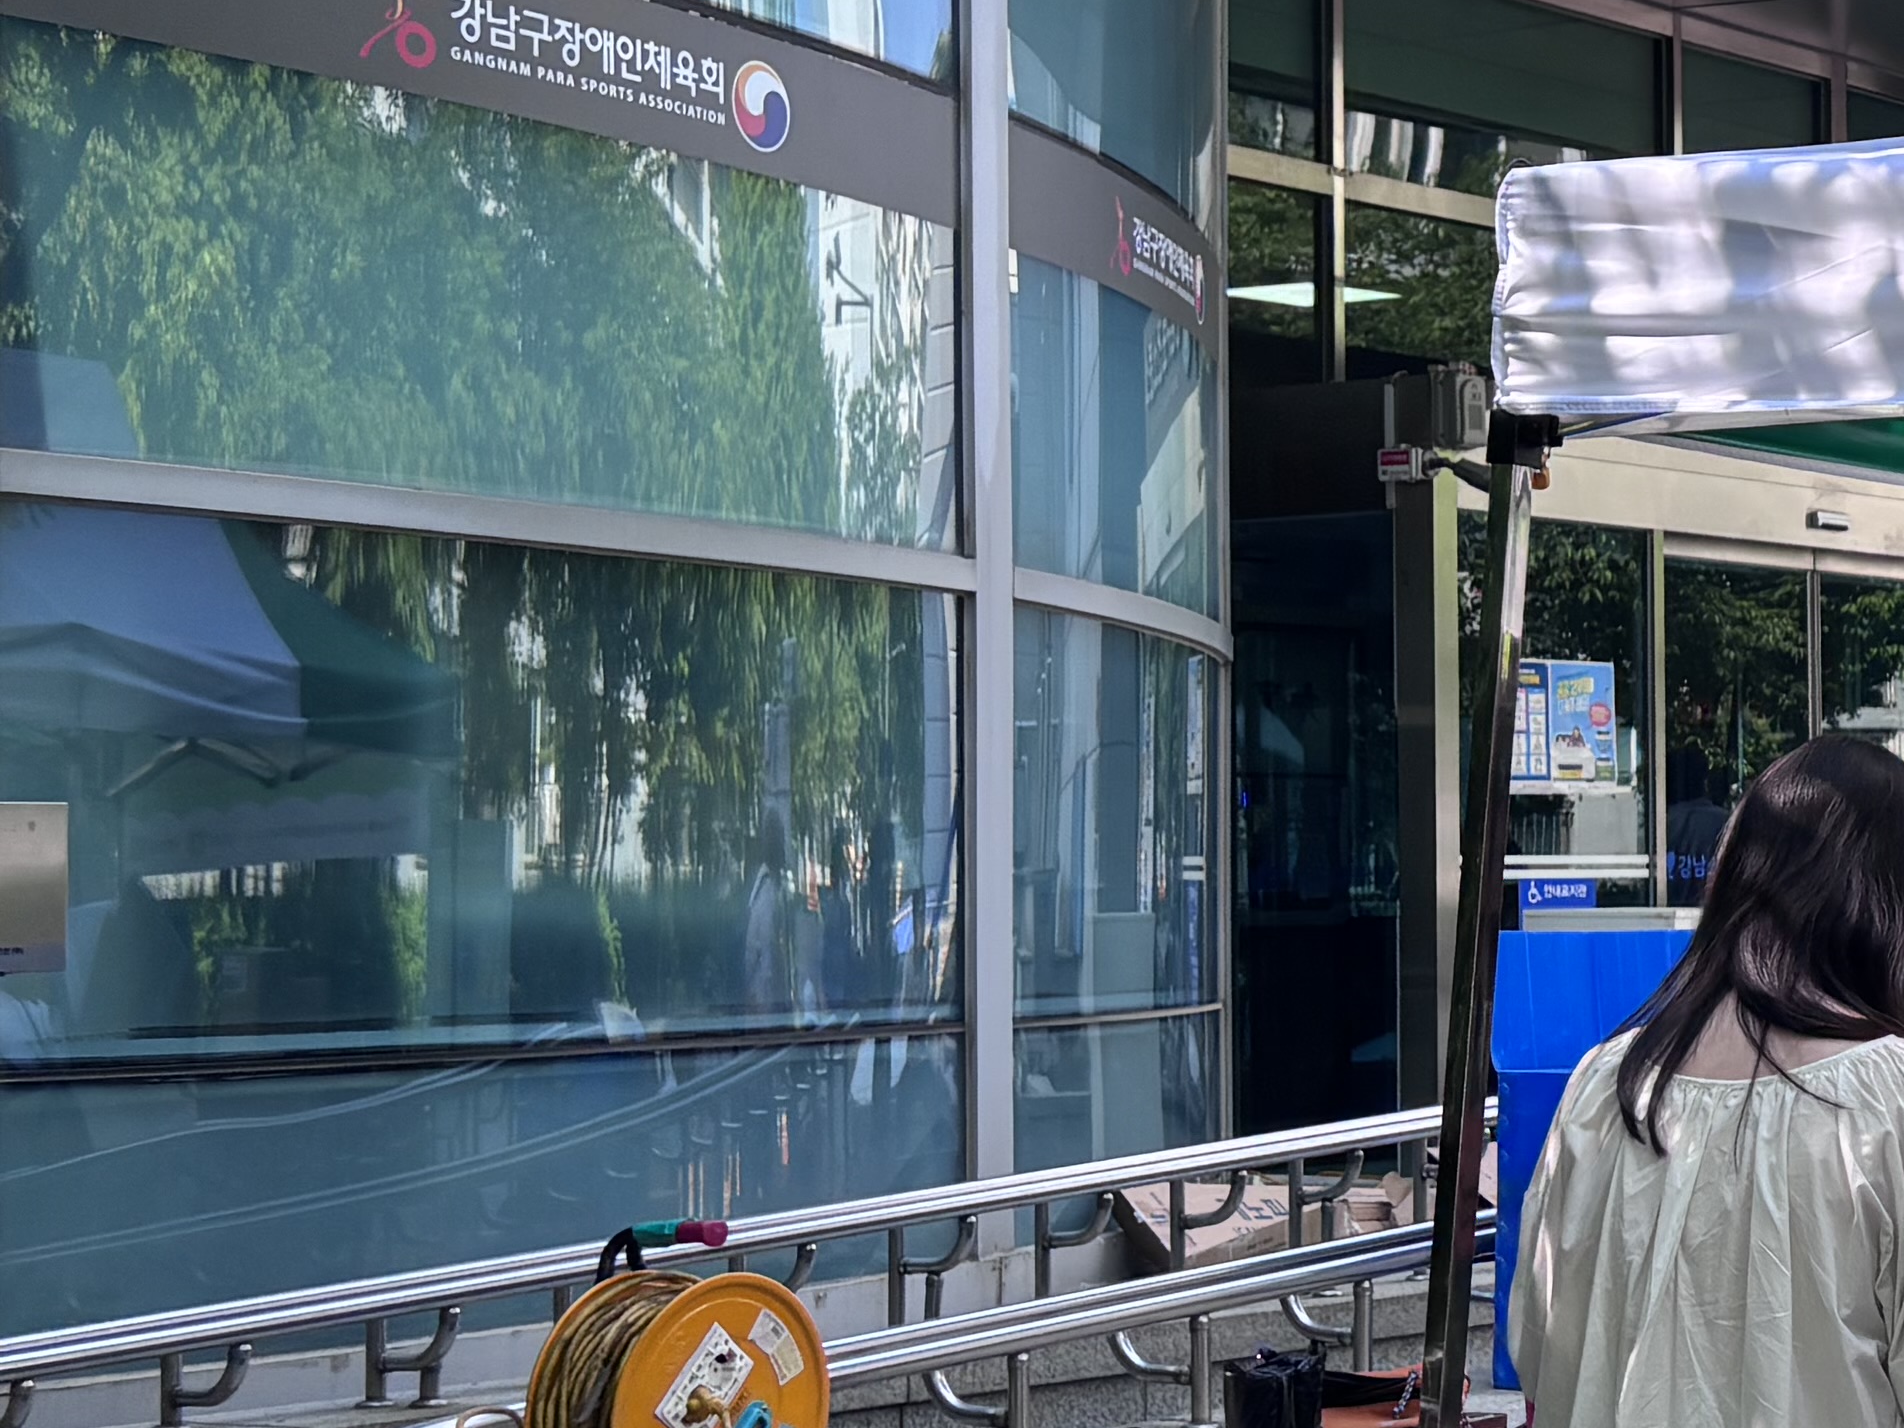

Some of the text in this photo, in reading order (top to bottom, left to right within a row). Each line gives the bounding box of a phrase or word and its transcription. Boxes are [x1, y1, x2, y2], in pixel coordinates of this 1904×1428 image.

[450, 45, 728, 127] GANGNAM PARA SPORTS ASSOCIATION
